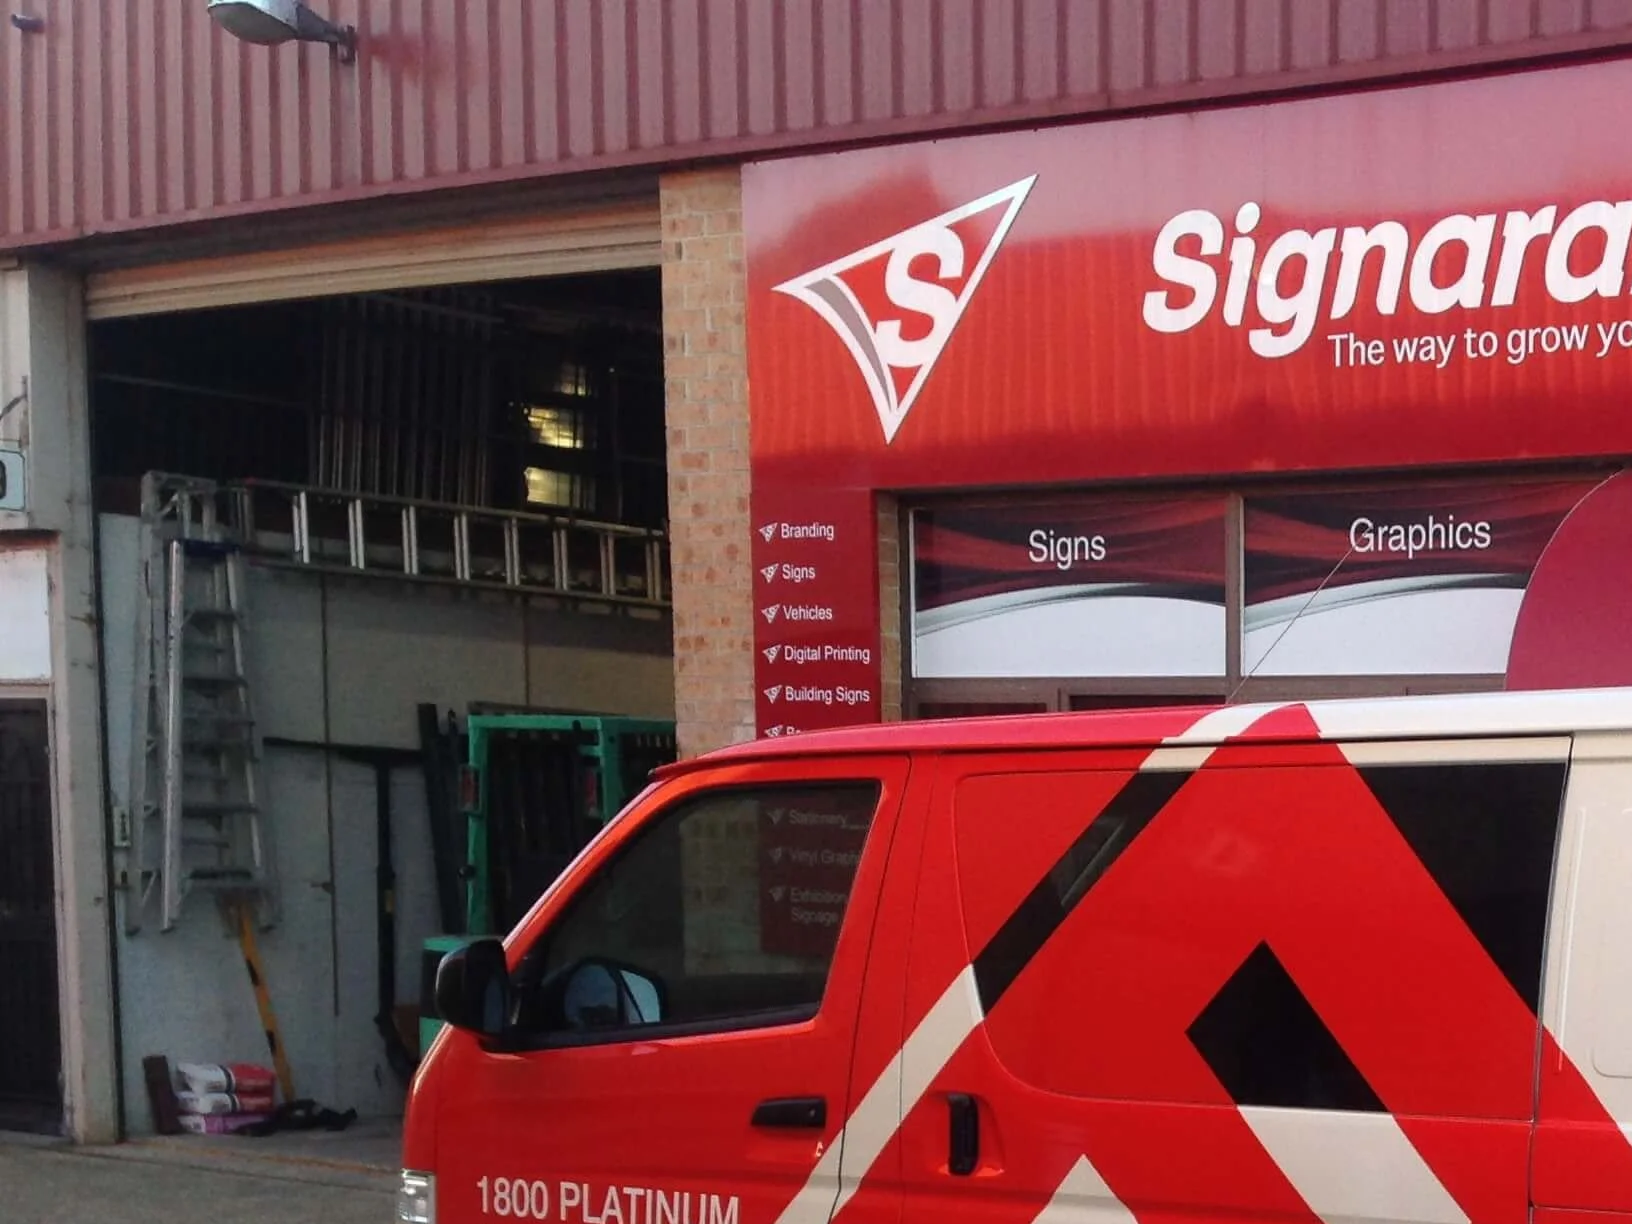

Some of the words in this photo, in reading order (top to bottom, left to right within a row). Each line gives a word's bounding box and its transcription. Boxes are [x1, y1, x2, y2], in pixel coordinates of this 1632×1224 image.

[1328, 333, 1384, 367] The
[1393, 334, 1455, 368] way
[1464, 328, 1497, 358] to
[1507, 324, 1589, 364] grow
[781, 522, 834, 541] Branding
[1349, 515, 1491, 560] Graphics
[1028, 530, 1106, 569] Signs
[782, 564, 816, 583] Signs
[783, 604, 833, 620] Vehicles
[784, 646, 821, 664] Digital
[824, 646, 871, 664] Printing
[785, 686, 832, 704] Building
[835, 686, 870, 705] Signs
[477, 1176, 548, 1220] 1800
